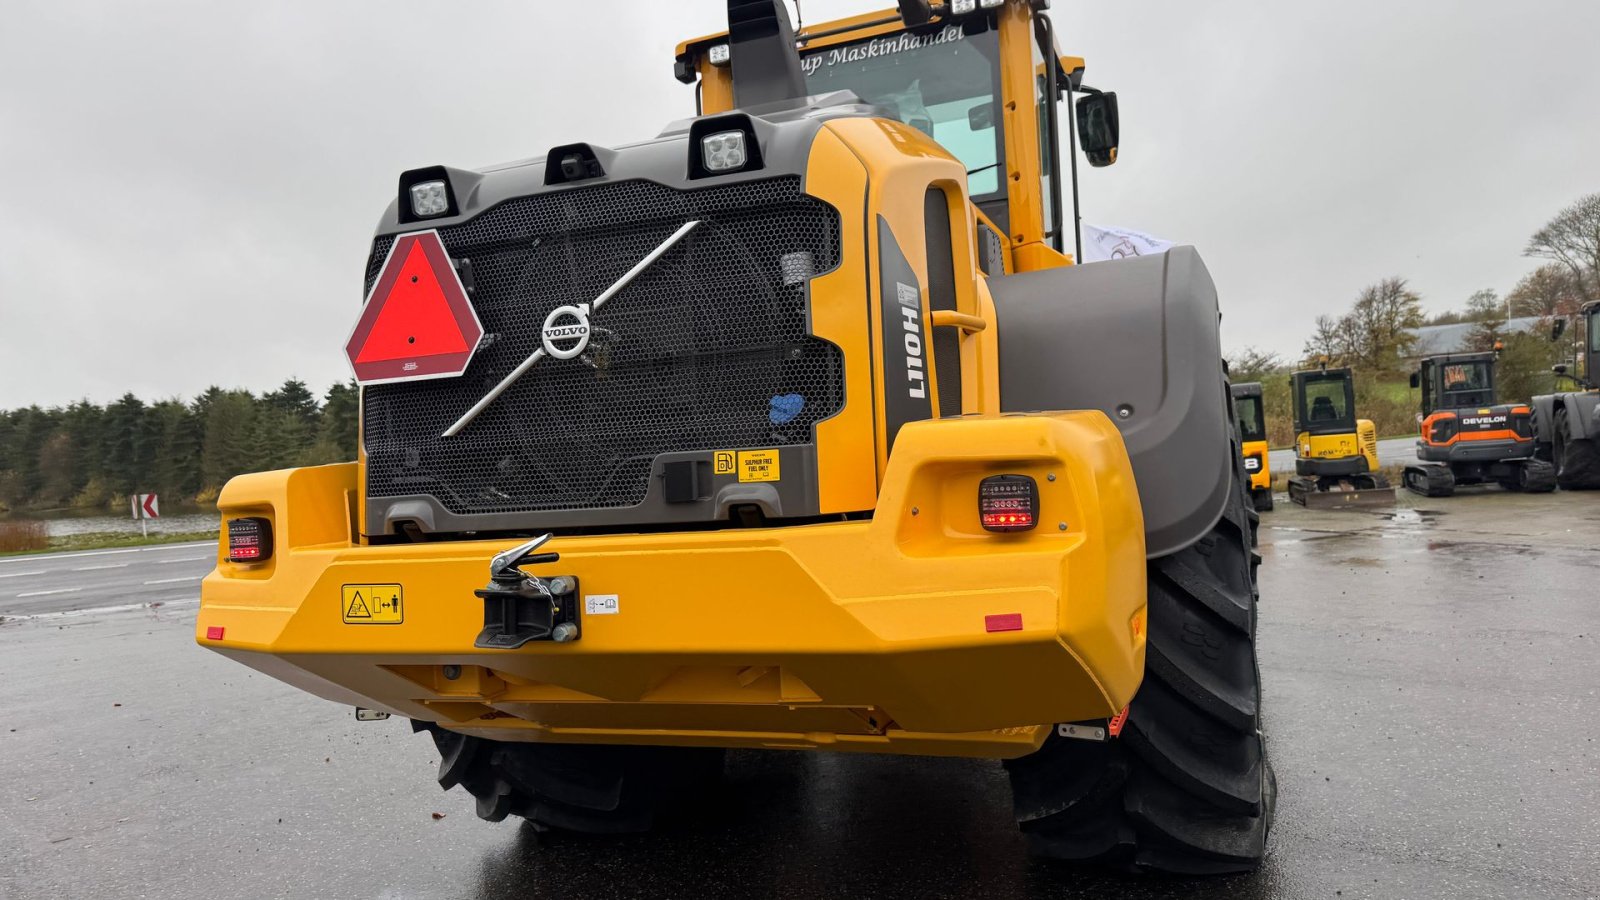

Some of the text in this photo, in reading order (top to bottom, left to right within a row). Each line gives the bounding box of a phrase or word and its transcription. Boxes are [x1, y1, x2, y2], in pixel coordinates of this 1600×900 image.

[828, 24, 965, 66] Maskinhandel
[544, 326, 588, 337] VOLVO
[901, 307, 925, 399] L110H
[1462, 415, 1507, 425] DEVELON
